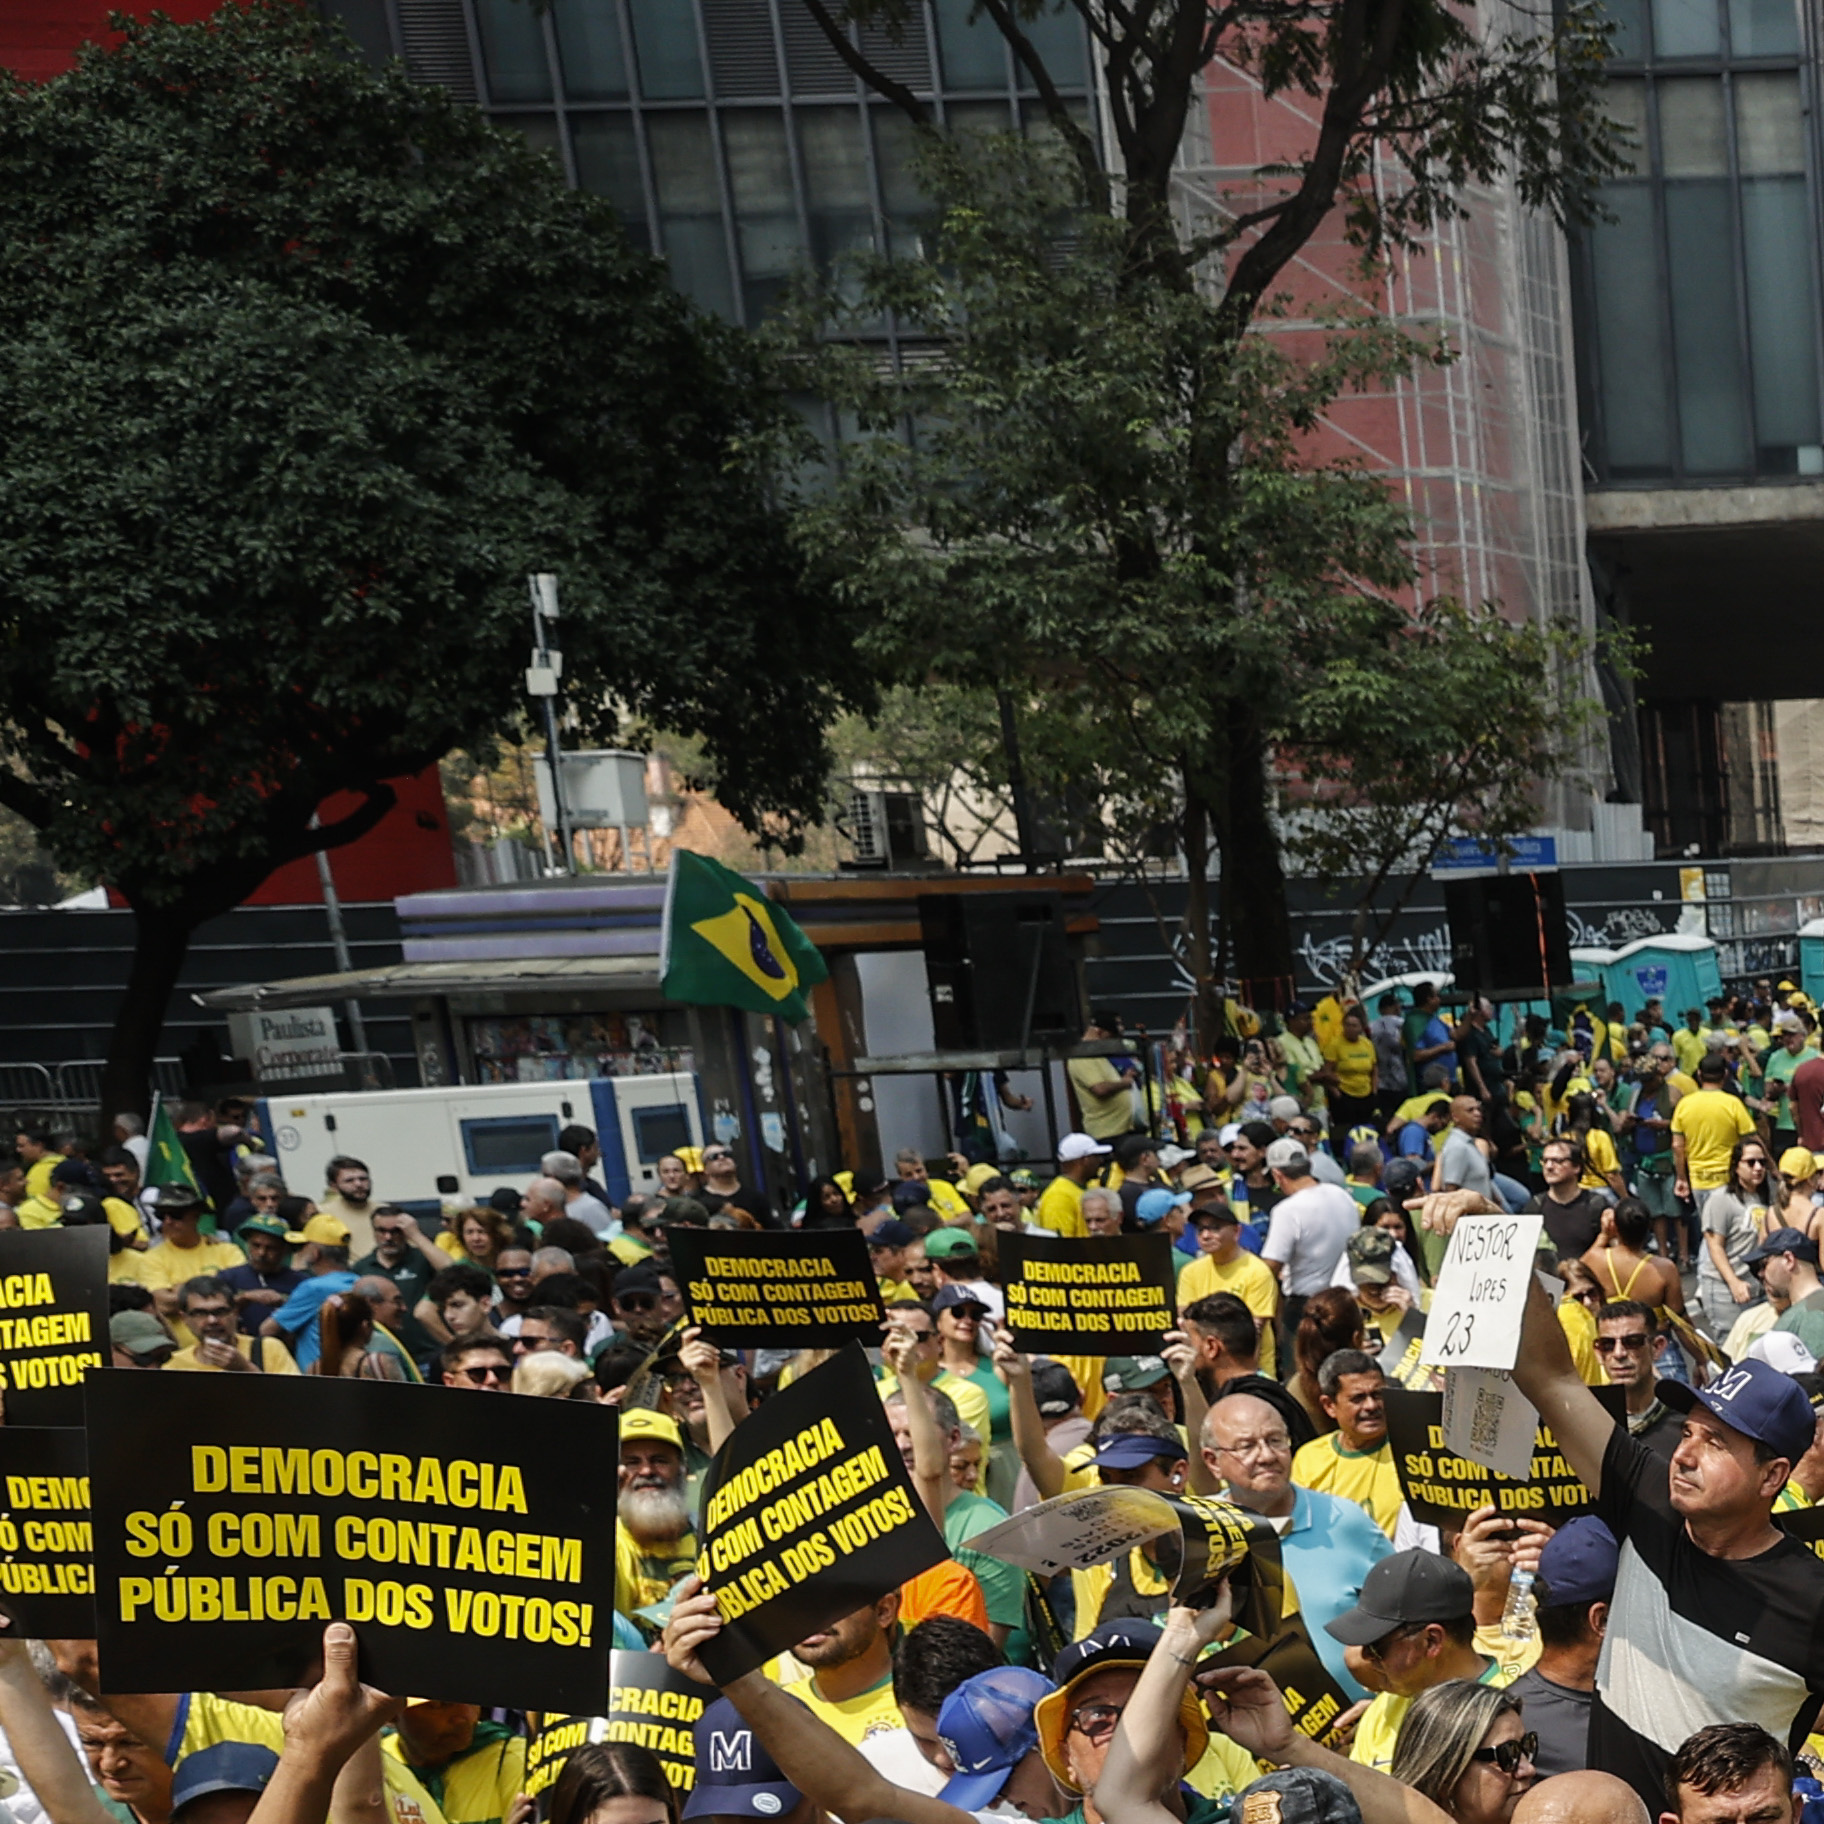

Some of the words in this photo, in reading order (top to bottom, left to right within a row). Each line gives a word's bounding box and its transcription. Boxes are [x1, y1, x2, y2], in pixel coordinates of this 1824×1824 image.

[1451, 1223, 1518, 1266] NESTOR
[704, 1256, 836, 1278] DEMOCRACIA
[1022, 1259, 1141, 1282] DEMOCRACIA
[688, 1277, 714, 1302] SÓ
[716, 1282, 757, 1302] COM
[760, 1280, 867, 1303] CONTAGEM
[1006, 1282, 1028, 1305] SÓ
[1029, 1286, 1068, 1306] COM
[1070, 1285, 1165, 1307] CONTAGEM
[691, 1302, 771, 1326] PÚBLICA
[774, 1306, 808, 1325] DOS
[811, 1303, 879, 1325] VOTOS!
[1006, 1305, 1074, 1331] PÚBLICA
[1076, 1312, 1111, 1331] DOS
[1114, 1310, 1173, 1331] VOTOS!
[1439, 1311, 1475, 1356] 23
[191, 1445, 528, 1515] DEMOCRACIA
[706, 1416, 846, 1534] DEMOCRACIA
[1405, 1450, 1434, 1478] SÓ
[711, 1517, 764, 1573] COM
[760, 1444, 889, 1542] CONTAGEM
[1500, 1487, 1544, 1511] DOS
[124, 1500, 193, 1558] SÓ
[207, 1512, 320, 1558] COM
[334, 1515, 582, 1583] CONTAGEM
[780, 1532, 836, 1584] DOS
[827, 1485, 916, 1555] VOTOS!
[119, 1565, 332, 1622] PÚBLICA
[344, 1578, 435, 1629] DOS
[445, 1587, 594, 1647] VOTOS!
[709, 1730, 752, 1772] M
